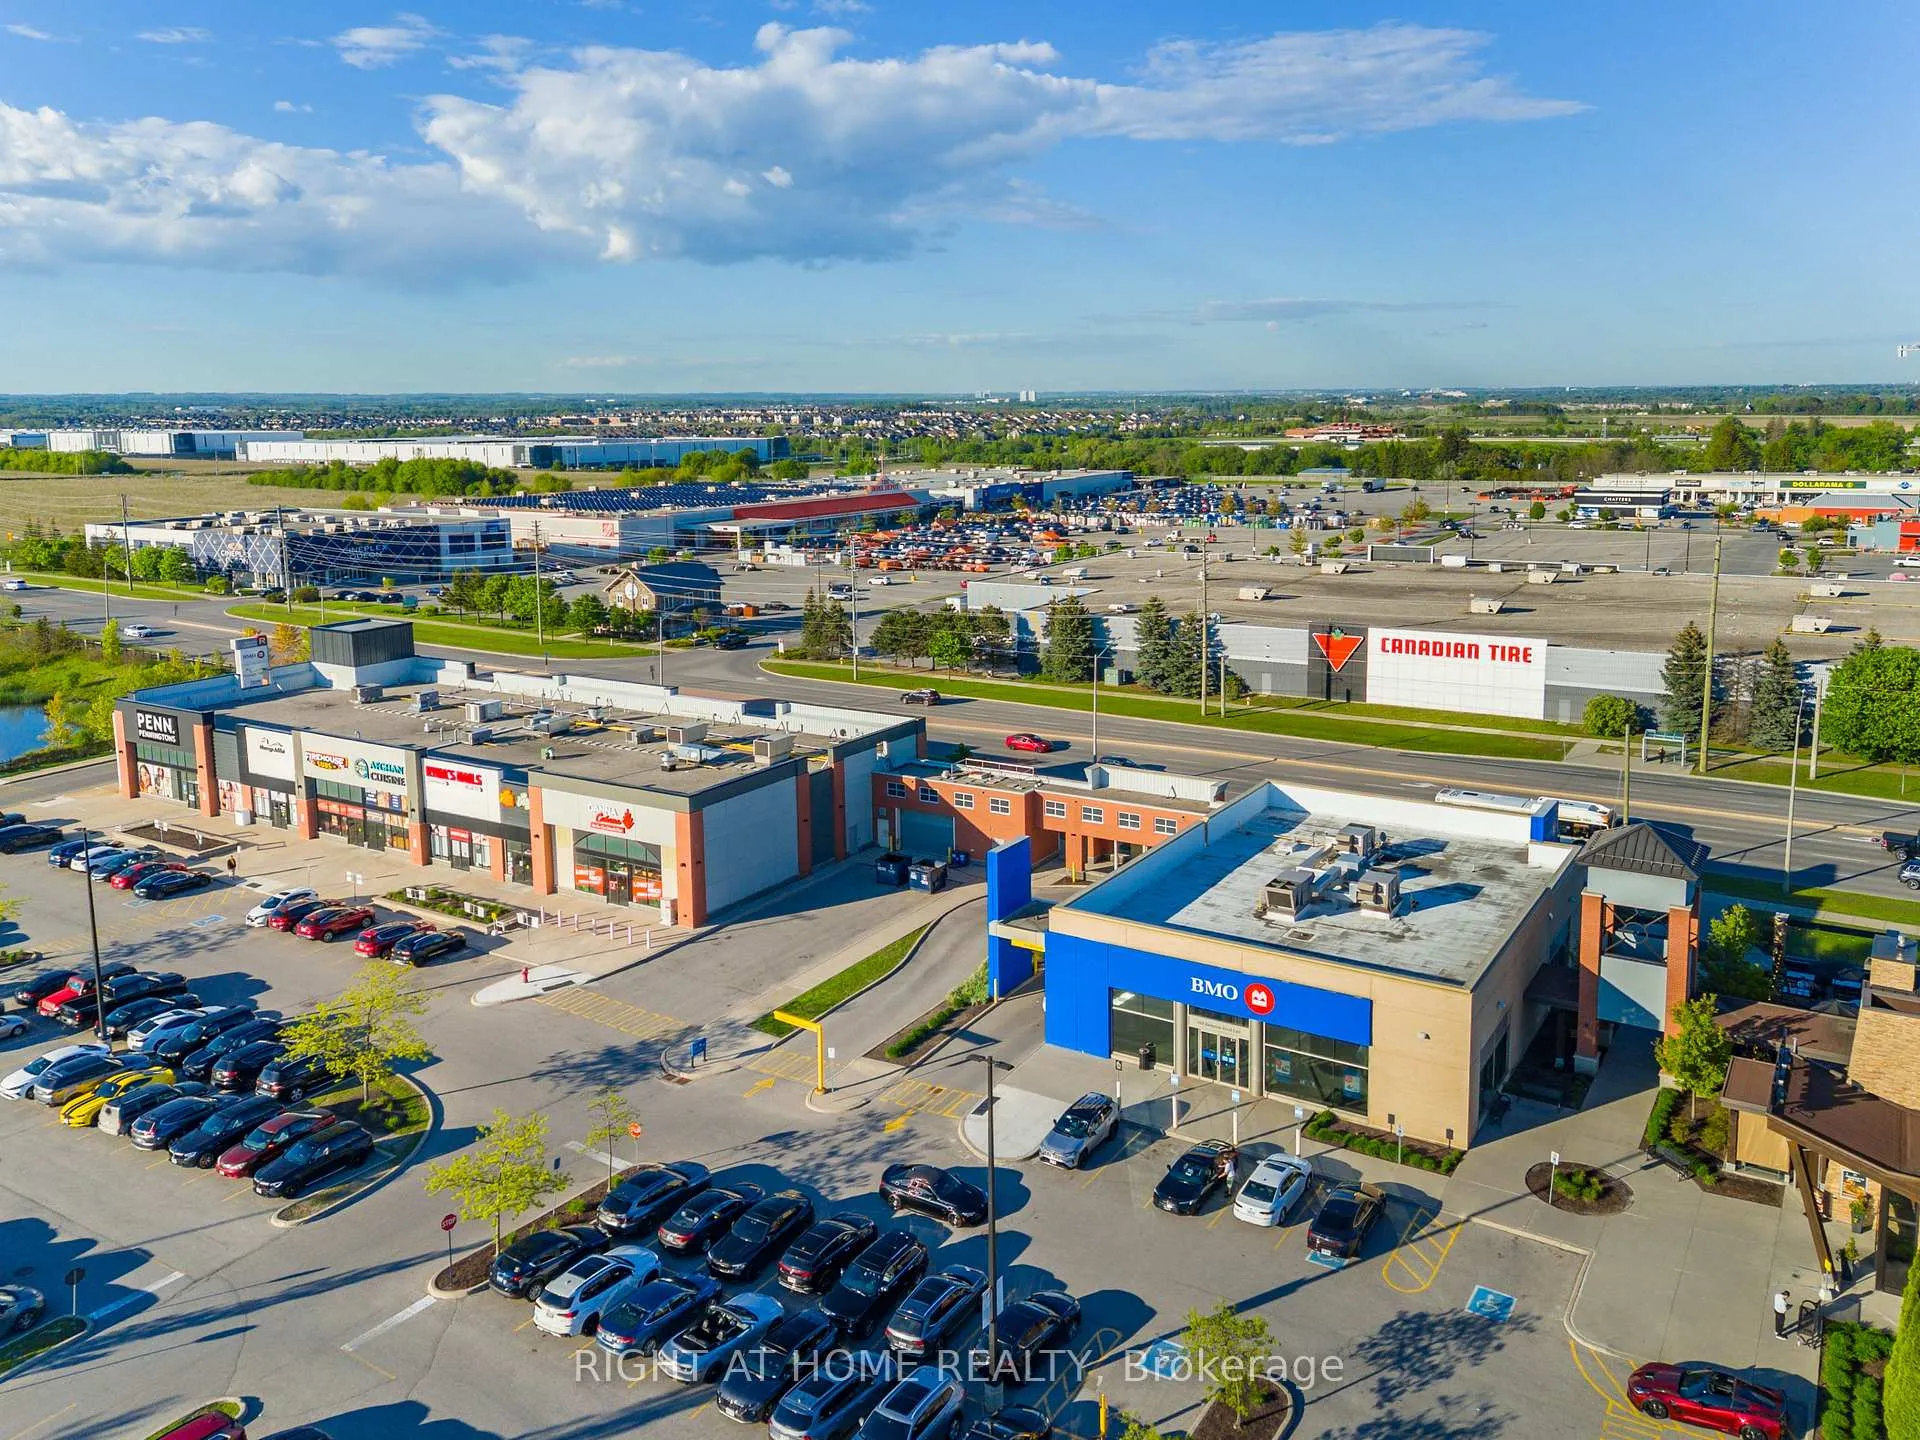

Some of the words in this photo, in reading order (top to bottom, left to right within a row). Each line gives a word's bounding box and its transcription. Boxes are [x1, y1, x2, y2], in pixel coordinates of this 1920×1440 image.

[1380, 637, 1480, 659] CANADIAN
[1488, 644, 1532, 663] TIRE
[136, 712, 176, 735] PENN.
[370, 761, 404, 774] AFGHAN
[1190, 976, 1239, 1001] BMO
